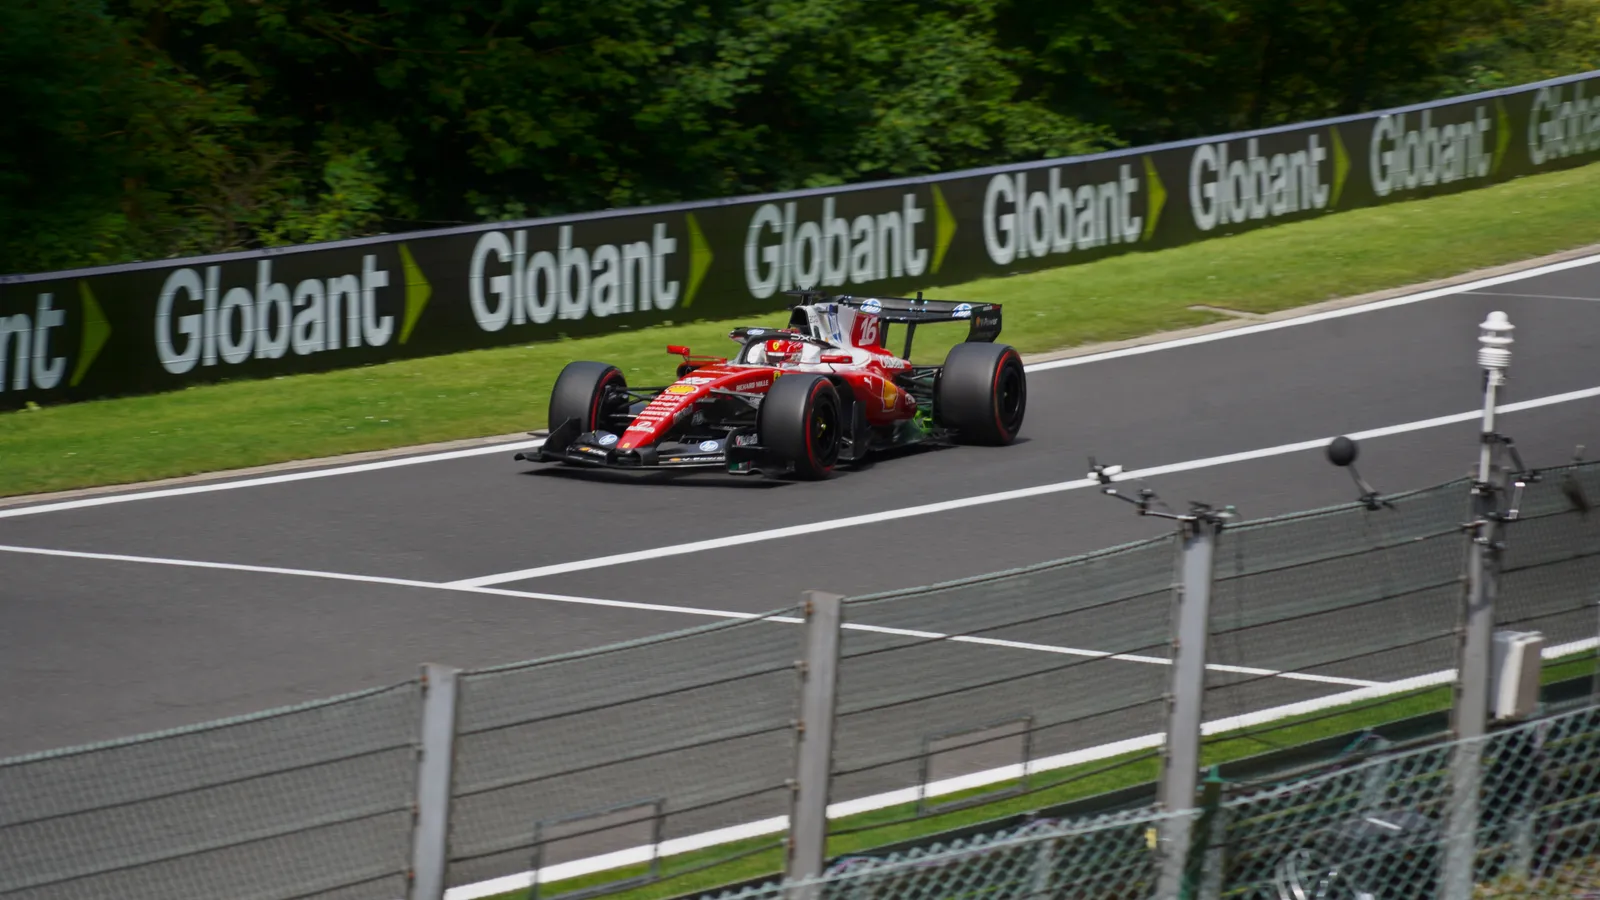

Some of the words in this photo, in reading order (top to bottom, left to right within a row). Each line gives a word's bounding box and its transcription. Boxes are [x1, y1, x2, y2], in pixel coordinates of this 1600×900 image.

[1190, 135, 1329, 231] Globant
[1370, 105, 1492, 197] Globant
[745, 193, 929, 300] Globant
[983, 164, 1142, 265] Globant
[156, 255, 394, 375] Globant
[470, 223, 680, 332] Globant
[859, 316, 878, 346] 16
[736, 382, 756, 391] RICHARD
[756, 379, 769, 387] MILLE
